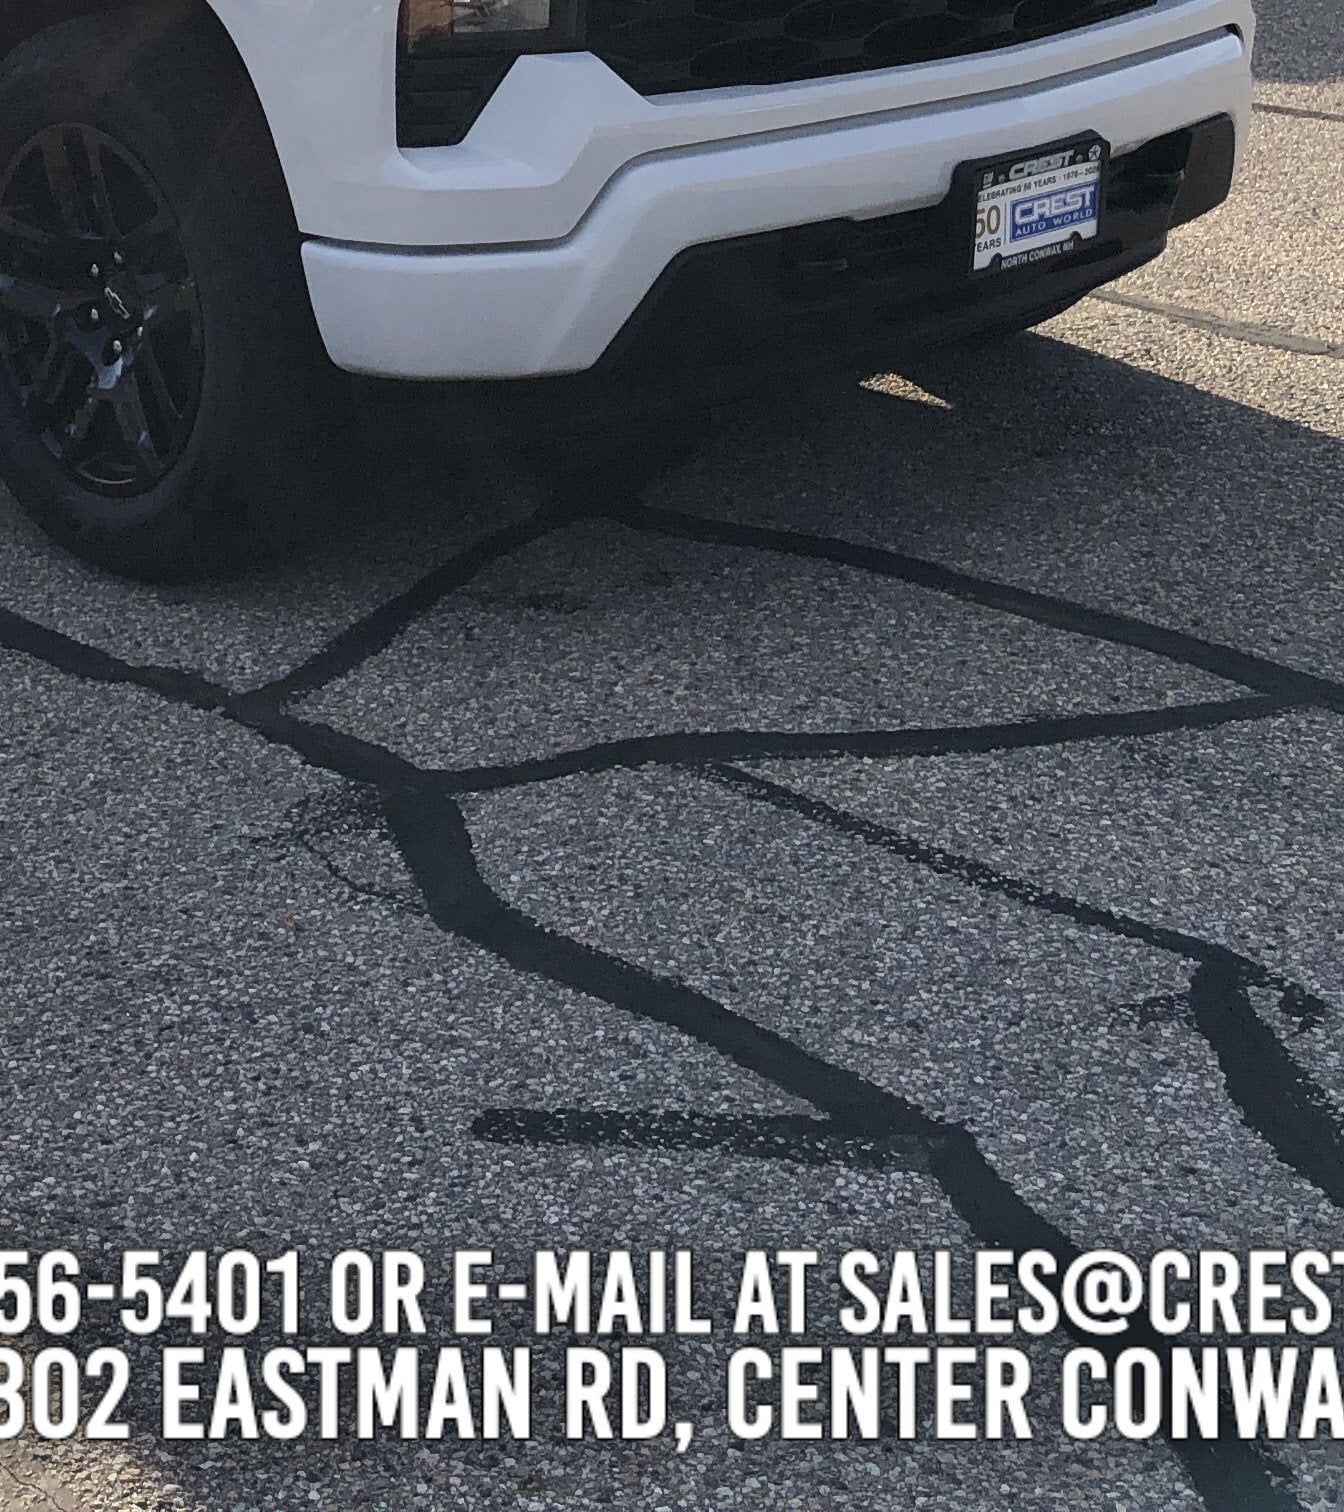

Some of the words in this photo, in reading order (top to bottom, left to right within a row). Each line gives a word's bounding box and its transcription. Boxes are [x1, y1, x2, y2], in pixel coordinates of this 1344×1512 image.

[1010, 150, 1075, 181] CREST
[978, 184, 1021, 202] ELEBRATING
[1034, 175, 1057, 189] YEARS
[1016, 185, 1095, 226] CREST
[976, 204, 1001, 239] 50
[1016, 221, 1047, 237] AUTO
[1053, 209, 1093, 226] WORLD
[977, 238, 1001, 252] EARS
[1002, 253, 1028, 270] NORTH
